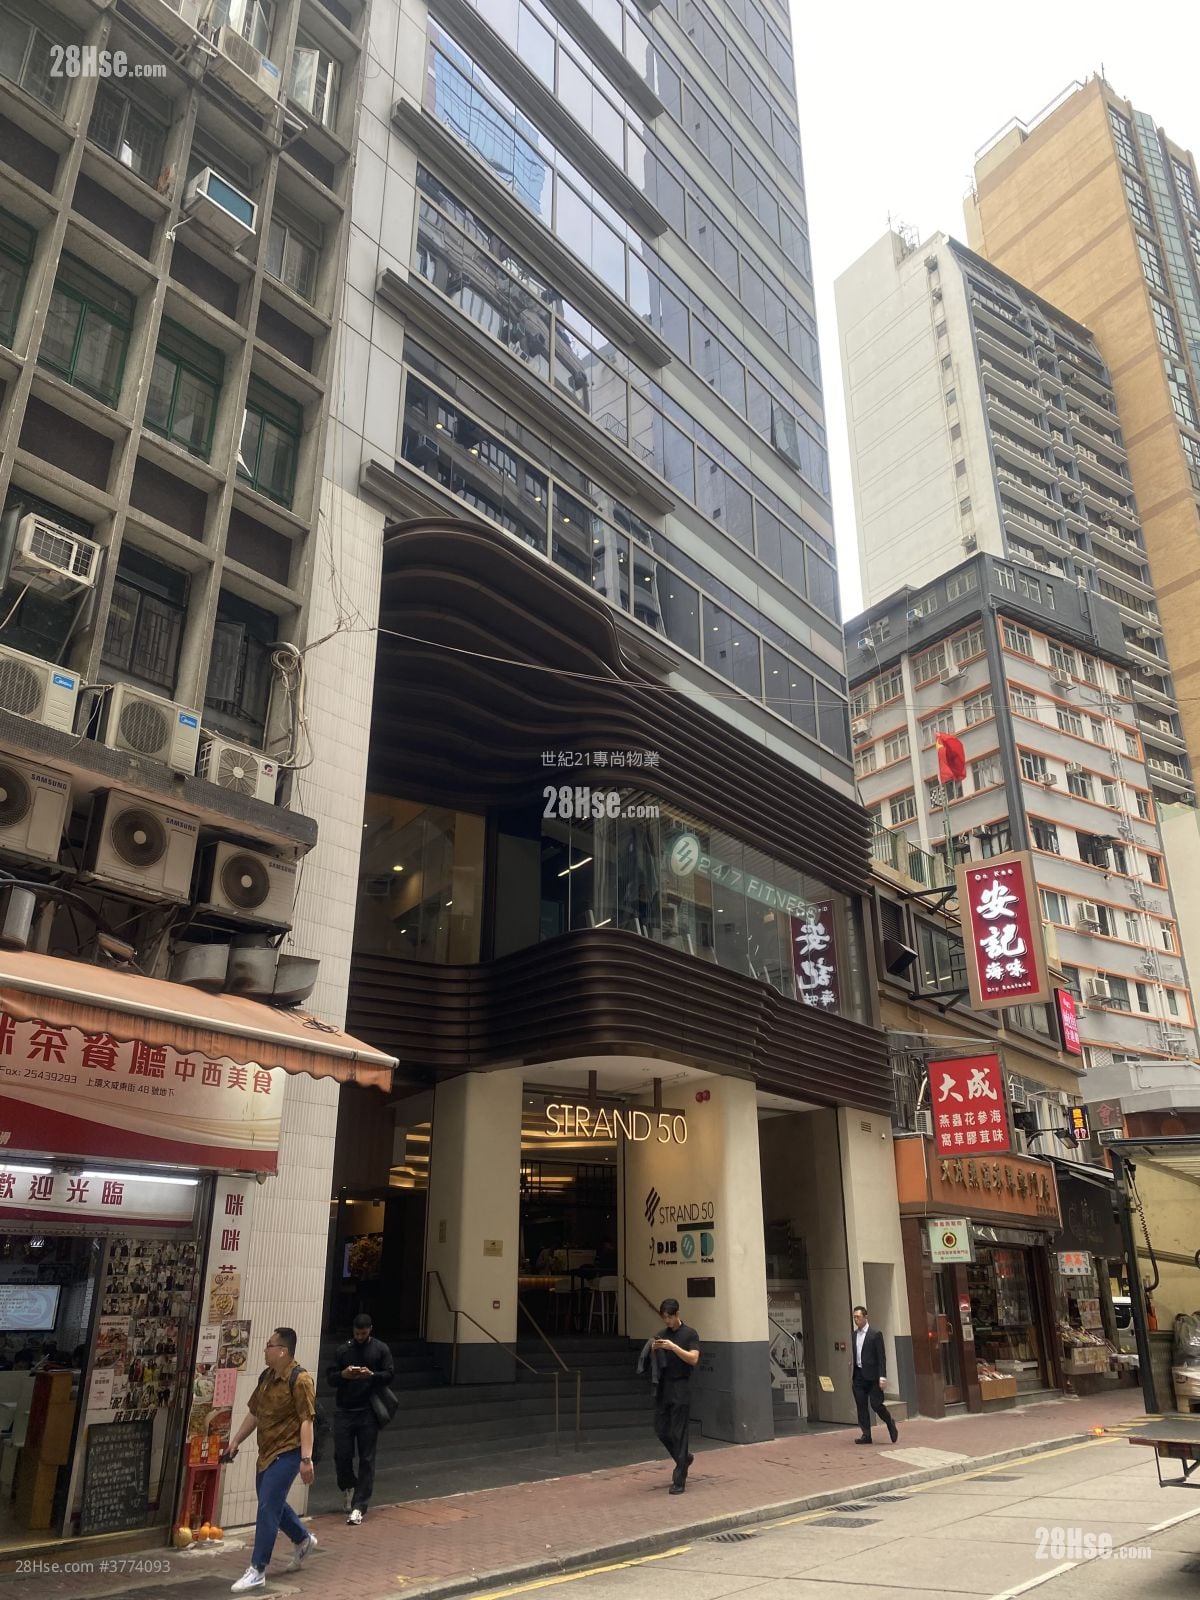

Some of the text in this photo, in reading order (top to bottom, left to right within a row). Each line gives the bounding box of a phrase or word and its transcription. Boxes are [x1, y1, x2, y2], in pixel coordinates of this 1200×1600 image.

[31, 773, 67, 790] SAMSUNG
[166, 817, 197, 832] SAMSUNG
[268, 861, 296, 874] SAMSUNG
[698, 857, 742, 885] 24/7
[976, 880, 1027, 960] 安記
[985, 958, 1026, 980] 海味
[24, 1068, 77, 1084] 25439293
[175, 1058, 273, 1095] 中西美食
[938, 1068, 997, 1102] 大成
[546, 1103, 688, 1145] STRAND 50
[0, 1173, 125, 1206] 歡迎光臨
[659, 1201, 714, 1225] STRAND 50
